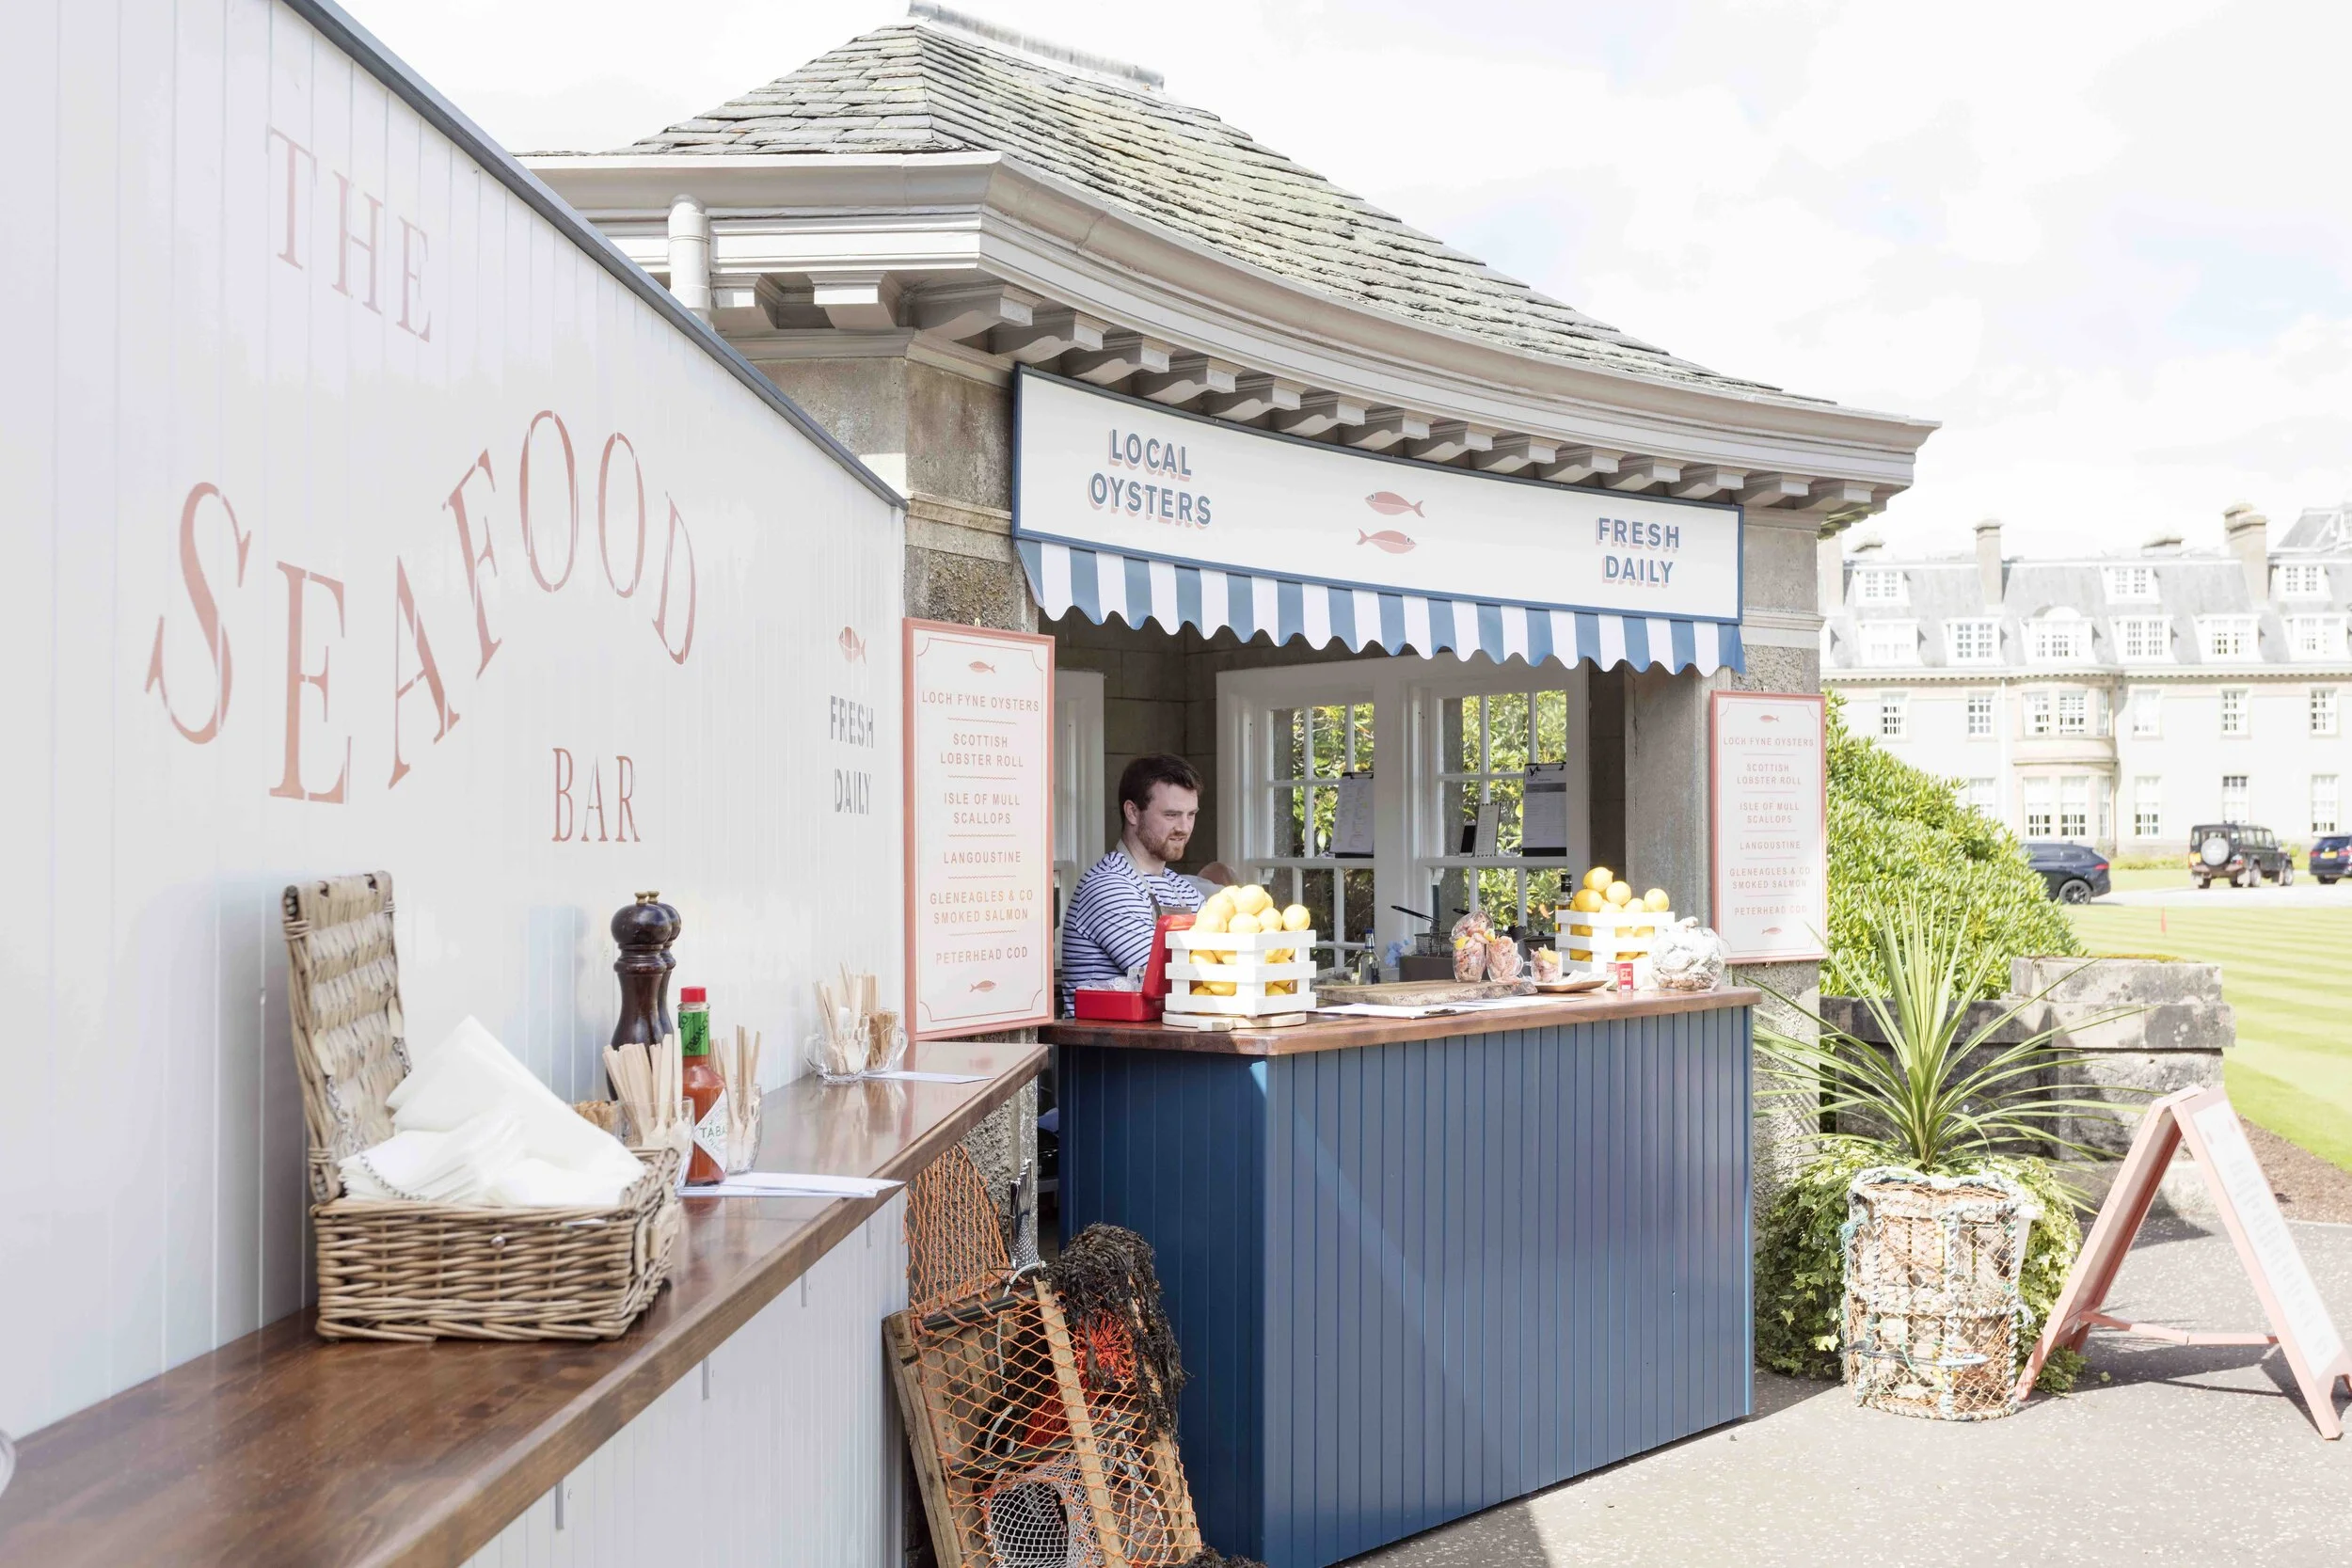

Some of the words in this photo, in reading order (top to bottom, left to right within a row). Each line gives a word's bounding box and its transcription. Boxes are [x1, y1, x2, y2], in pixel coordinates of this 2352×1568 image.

[265, 126, 432, 343] THE
[1108, 429, 1192, 482] LOCAL
[1088, 473, 1212, 531] OYSTERS
[1596, 516, 1680, 554] FRESH
[1602, 555, 1674, 588] DAILY
[145, 408, 698, 806] SEAFOOD
[922, 690, 952, 705] LOCH
[958, 693, 986, 708] FYNE
[991, 697, 1040, 712] OYSTERS
[830, 695, 874, 749] FRESH
[953, 733, 1008, 748] SCOTTISH
[1724, 737, 1746, 746] LOCH
[1750, 737, 1772, 746] FYNE
[1774, 737, 1814, 747] OYSTERS
[941, 752, 992, 767] LOBSTER
[996, 754, 1024, 768] ROLL
[1746, 763, 1789, 772] SCOTTISH
[1737, 776, 1777, 785] LOBSTER
[1780, 776, 1802, 785] ROLL
[551, 747, 642, 844] BAR
[834, 768, 871, 816] DAILY
[944, 792, 969, 805] ISLE
[974, 793, 988, 806] OF
[993, 793, 1020, 806] MULL
[1740, 802, 1758, 811] ISLE
[1762, 802, 1773, 811] OF
[1776, 802, 1800, 811] MULL
[953, 812, 1011, 825] SCALLOPS
[1747, 815, 1792, 824] SCALLOPS
[1740, 841, 1801, 850] LANGOUSTINE
[944, 851, 1022, 864] LANGOUSTINE
[1729, 867, 1788, 877] GLENEAGLES
[1732, 880, 1769, 890] SMOKED
[1772, 879, 1806, 889] SALMON
[930, 890, 1004, 905] GLENEAGLES
[1009, 890, 1015, 903] &
[1019, 889, 1033, 901] CO
[933, 910, 980, 925] SMOKED
[985, 908, 1028, 923] SALMON
[1735, 906, 1786, 916] PETERHEAD
[936, 947, 1002, 964] PETERHEAD
[1007, 946, 1027, 959] COD
